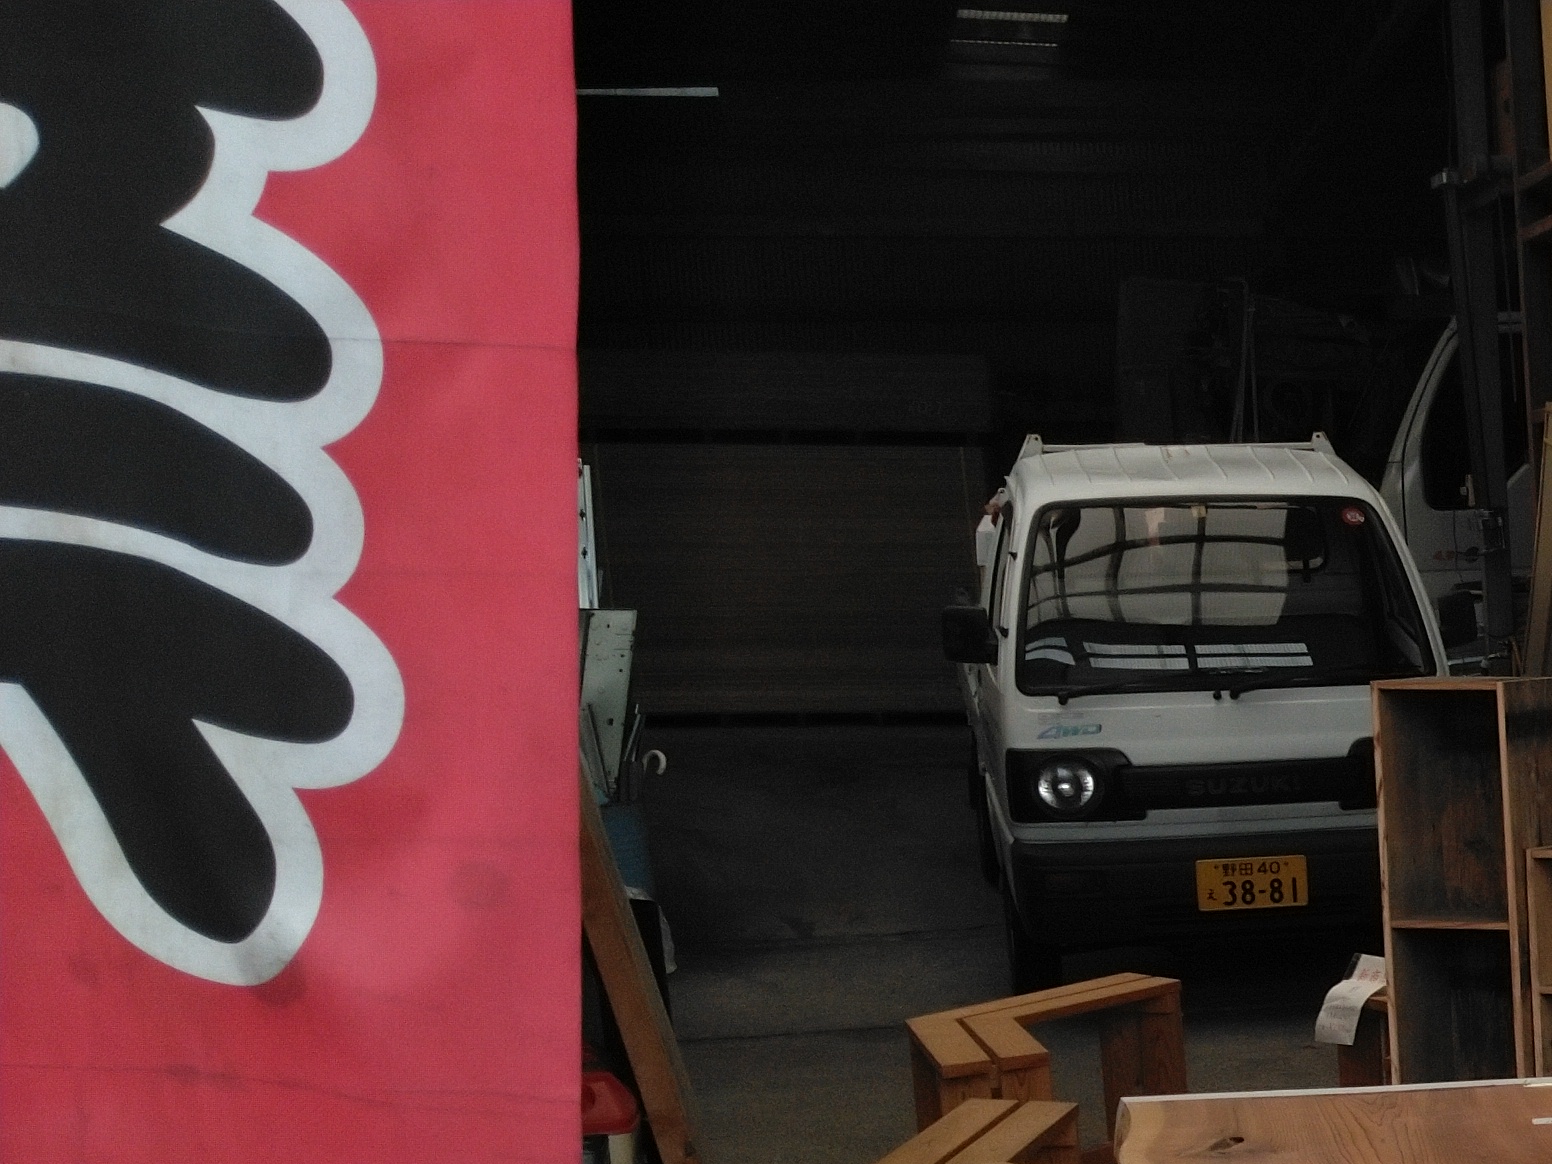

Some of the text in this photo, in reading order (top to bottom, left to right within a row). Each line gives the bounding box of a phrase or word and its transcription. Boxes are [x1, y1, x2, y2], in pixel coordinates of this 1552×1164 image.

[1222, 861, 1281, 877] 野田 40
[1222, 877, 1299, 906] 38-81
